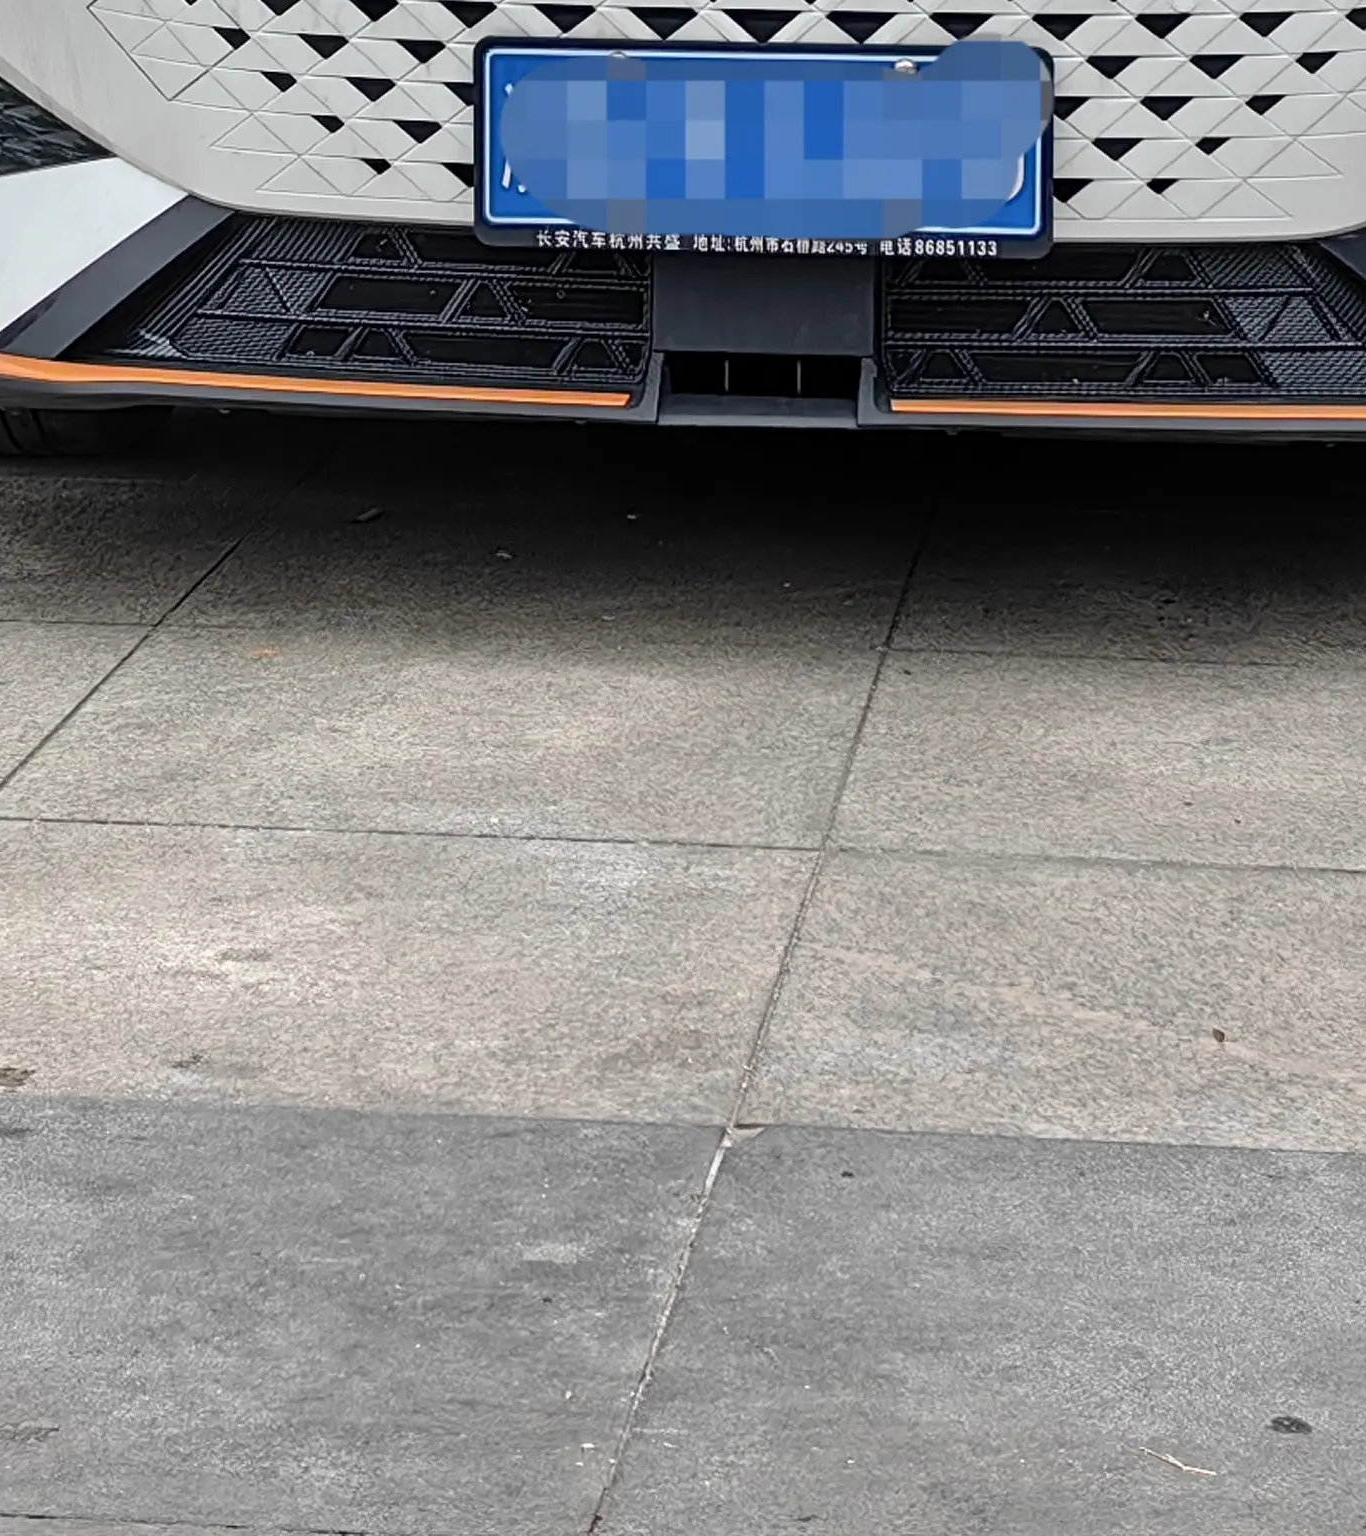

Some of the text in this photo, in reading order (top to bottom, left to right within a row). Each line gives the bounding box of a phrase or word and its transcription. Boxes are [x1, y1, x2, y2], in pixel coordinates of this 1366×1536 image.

[536, 230, 681, 251] 长安汽车杭州共盛
[880, 238, 998, 256] 电话86851133
